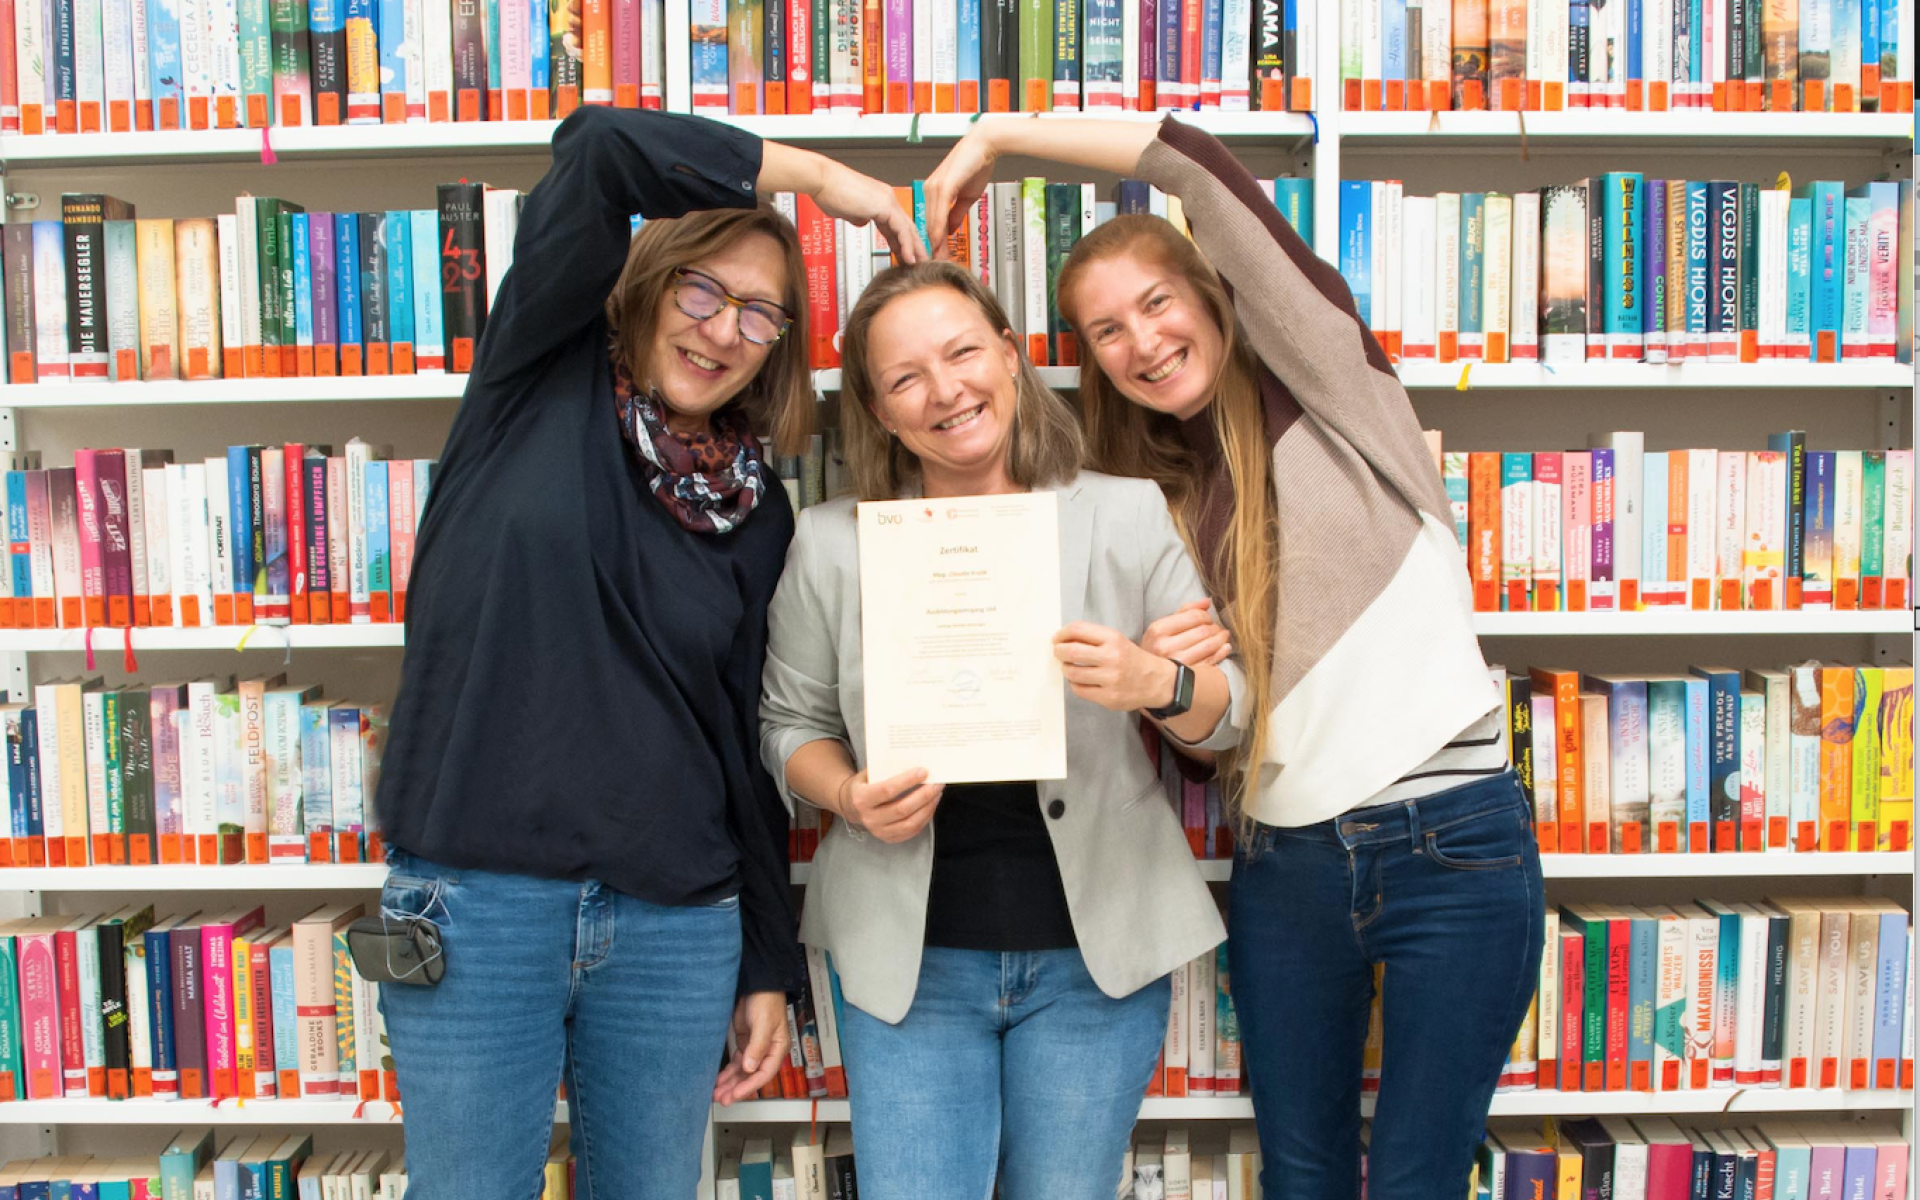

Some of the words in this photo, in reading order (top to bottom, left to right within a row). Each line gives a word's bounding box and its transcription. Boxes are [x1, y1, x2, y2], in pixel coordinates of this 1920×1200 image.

[1089, 18, 1120, 26] NICHT
[508, 36, 518, 75] ISABEL
[597, 29, 605, 67] ALLENDE
[837, 30, 847, 52] DIE
[850, 40, 859, 66] DER
[1090, 36, 1121, 45] SEHEN
[244, 40, 255, 90] Cecelia
[256, 36, 269, 79] Ahern
[289, 48, 297, 81] AHERN
[319, 41, 328, 88] CECELIA
[327, 47, 335, 81] AHERN
[792, 55, 799, 64] IN
[440, 212, 480, 221] AUSTER
[445, 203, 471, 211] PAUL
[978, 193, 988, 221] STILL
[1655, 186, 1664, 214] ELIAS
[264, 217, 276, 256] Omka
[812, 219, 822, 255] NACHT
[822, 214, 833, 254] WÄCHT
[978, 224, 988, 242] SO
[1674, 220, 1684, 258] MALUS
[1691, 188, 1706, 260] VIGDIS
[1722, 188, 1736, 260] VIGDIS
[1792, 228, 1800, 245] ICH
[1800, 224, 1808, 251] LIEBE
[1848, 229, 1856, 242] EIN
[1860, 220, 1869, 235] MAL
[802, 234, 812, 255] DER
[957, 232, 967, 263] BLEIBT
[1655, 218, 1664, 264] HIRSCHL
[1848, 244, 1856, 266] NOCH
[1858, 237, 1869, 272] EINZIGES
[1878, 229, 1889, 264] VERITY
[978, 247, 989, 271] ALLE
[1030, 237, 1043, 289] HANNES
[1792, 249, 1800, 272] WEIL
[1800, 253, 1808, 277] WILL
[75, 234, 93, 326] MAUERSEGLER
[809, 266, 819, 303] LOUISE
[819, 265, 830, 311] ERDRICH
[1847, 267, 1856, 285] NUR
[264, 283, 273, 319] Barbara
[1875, 272, 1889, 318] HOOVER
[424, 318, 432, 334] DANI
[1790, 291, 1805, 333] HOOVER
[81, 332, 95, 353] DIE
[253, 484, 261, 526] Theodora
[312, 466, 324, 521] LUMPFISCH
[216, 515, 224, 558] PORTRAIT
[314, 524, 325, 566] GEMEINE
[939, 546, 978, 555] Zertifikat
[315, 569, 326, 587] DER
[200, 694, 212, 737] Besuch
[246, 694, 260, 765] FELDPOST
[1716, 690, 1724, 737] FREMDE
[1726, 694, 1734, 740] STRAND
[202, 747, 210, 782] BLUM
[1716, 741, 1724, 763] DER
[1726, 741, 1734, 760] AM
[168, 755, 179, 793] HOPE
[203, 791, 211, 821] HILA
[1743, 801, 1753, 814] LISA
[185, 945, 193, 968] MALT
[210, 937, 218, 968] THOMAS
[217, 935, 225, 968] BREZINA
[1801, 937, 1812, 958] ME
[1830, 930, 1841, 958] YOU
[1860, 941, 1870, 959] US
[308, 939, 317, 983] GEMÄLDE
[1610, 946, 1620, 994] CHAOS
[1662, 945, 1672, 999] RÜCKWÄRTS
[1674, 954, 1683, 990] WALZER
[1774, 945, 1784, 985] HEILUNG
[1883, 958, 1892, 994] kasten
[1892, 960, 1901, 988] again
[273, 970, 282, 995] Insel
[282, 963, 293, 1000] Herzen
[310, 985, 318, 1002] DAS
[1697, 949, 1714, 1031] MAKARIONISSI
[1799, 962, 1810, 994] SAVE
[1829, 962, 1839, 994] SAVE
[1858, 963, 1869, 996] SAVE
[255, 970, 266, 1020] GROSSMUTTER
[1890, 995, 1898, 1025] dream
[1633, 1004, 1642, 1037] RADIO
[1643, 999, 1652, 1045] ACTIVITY
[1667, 1005, 1676, 1037] Kaiser
[1882, 999, 1890, 1026] mona
[1, 1019, 10, 1059] BOMANN
[34, 1020, 43, 1053] CORINA
[42, 1016, 51, 1055] BOMANN
[257, 1021, 267, 1047] MEINER
[277, 1026, 287, 1065] Isabelle
[308, 1021, 318, 1071] GERALDINE
[317, 1020, 325, 1057] BROOKS
[1616, 1011, 1624, 1048] KABATEK
[257, 1050, 268, 1066] ZOPF
[1718, 1161, 1734, 1199] Knecht
